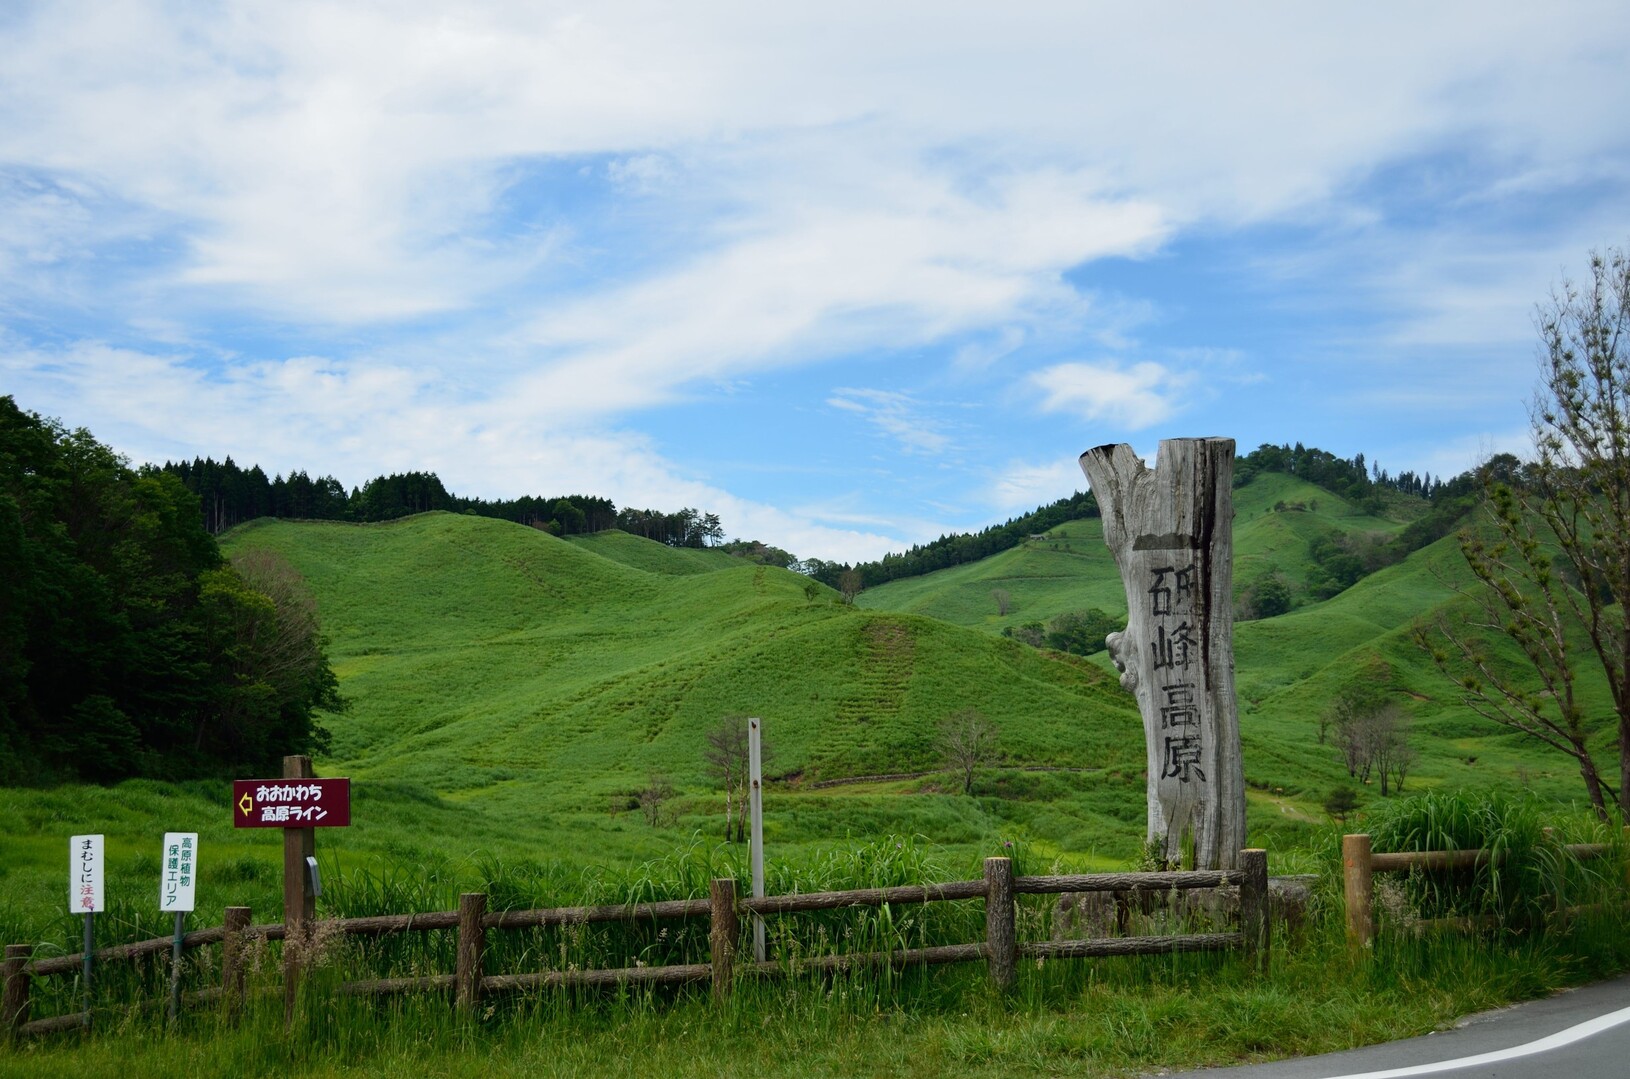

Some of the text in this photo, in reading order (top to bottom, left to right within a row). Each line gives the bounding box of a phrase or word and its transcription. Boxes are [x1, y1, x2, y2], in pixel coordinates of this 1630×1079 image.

[256, 784, 322, 802] おおかわち
[261, 805, 328, 822] 高原ライン
[80, 839, 95, 910] まむしに注意
[166, 844, 180, 907] 保護エリア
[180, 837, 193, 887] 高原植物
